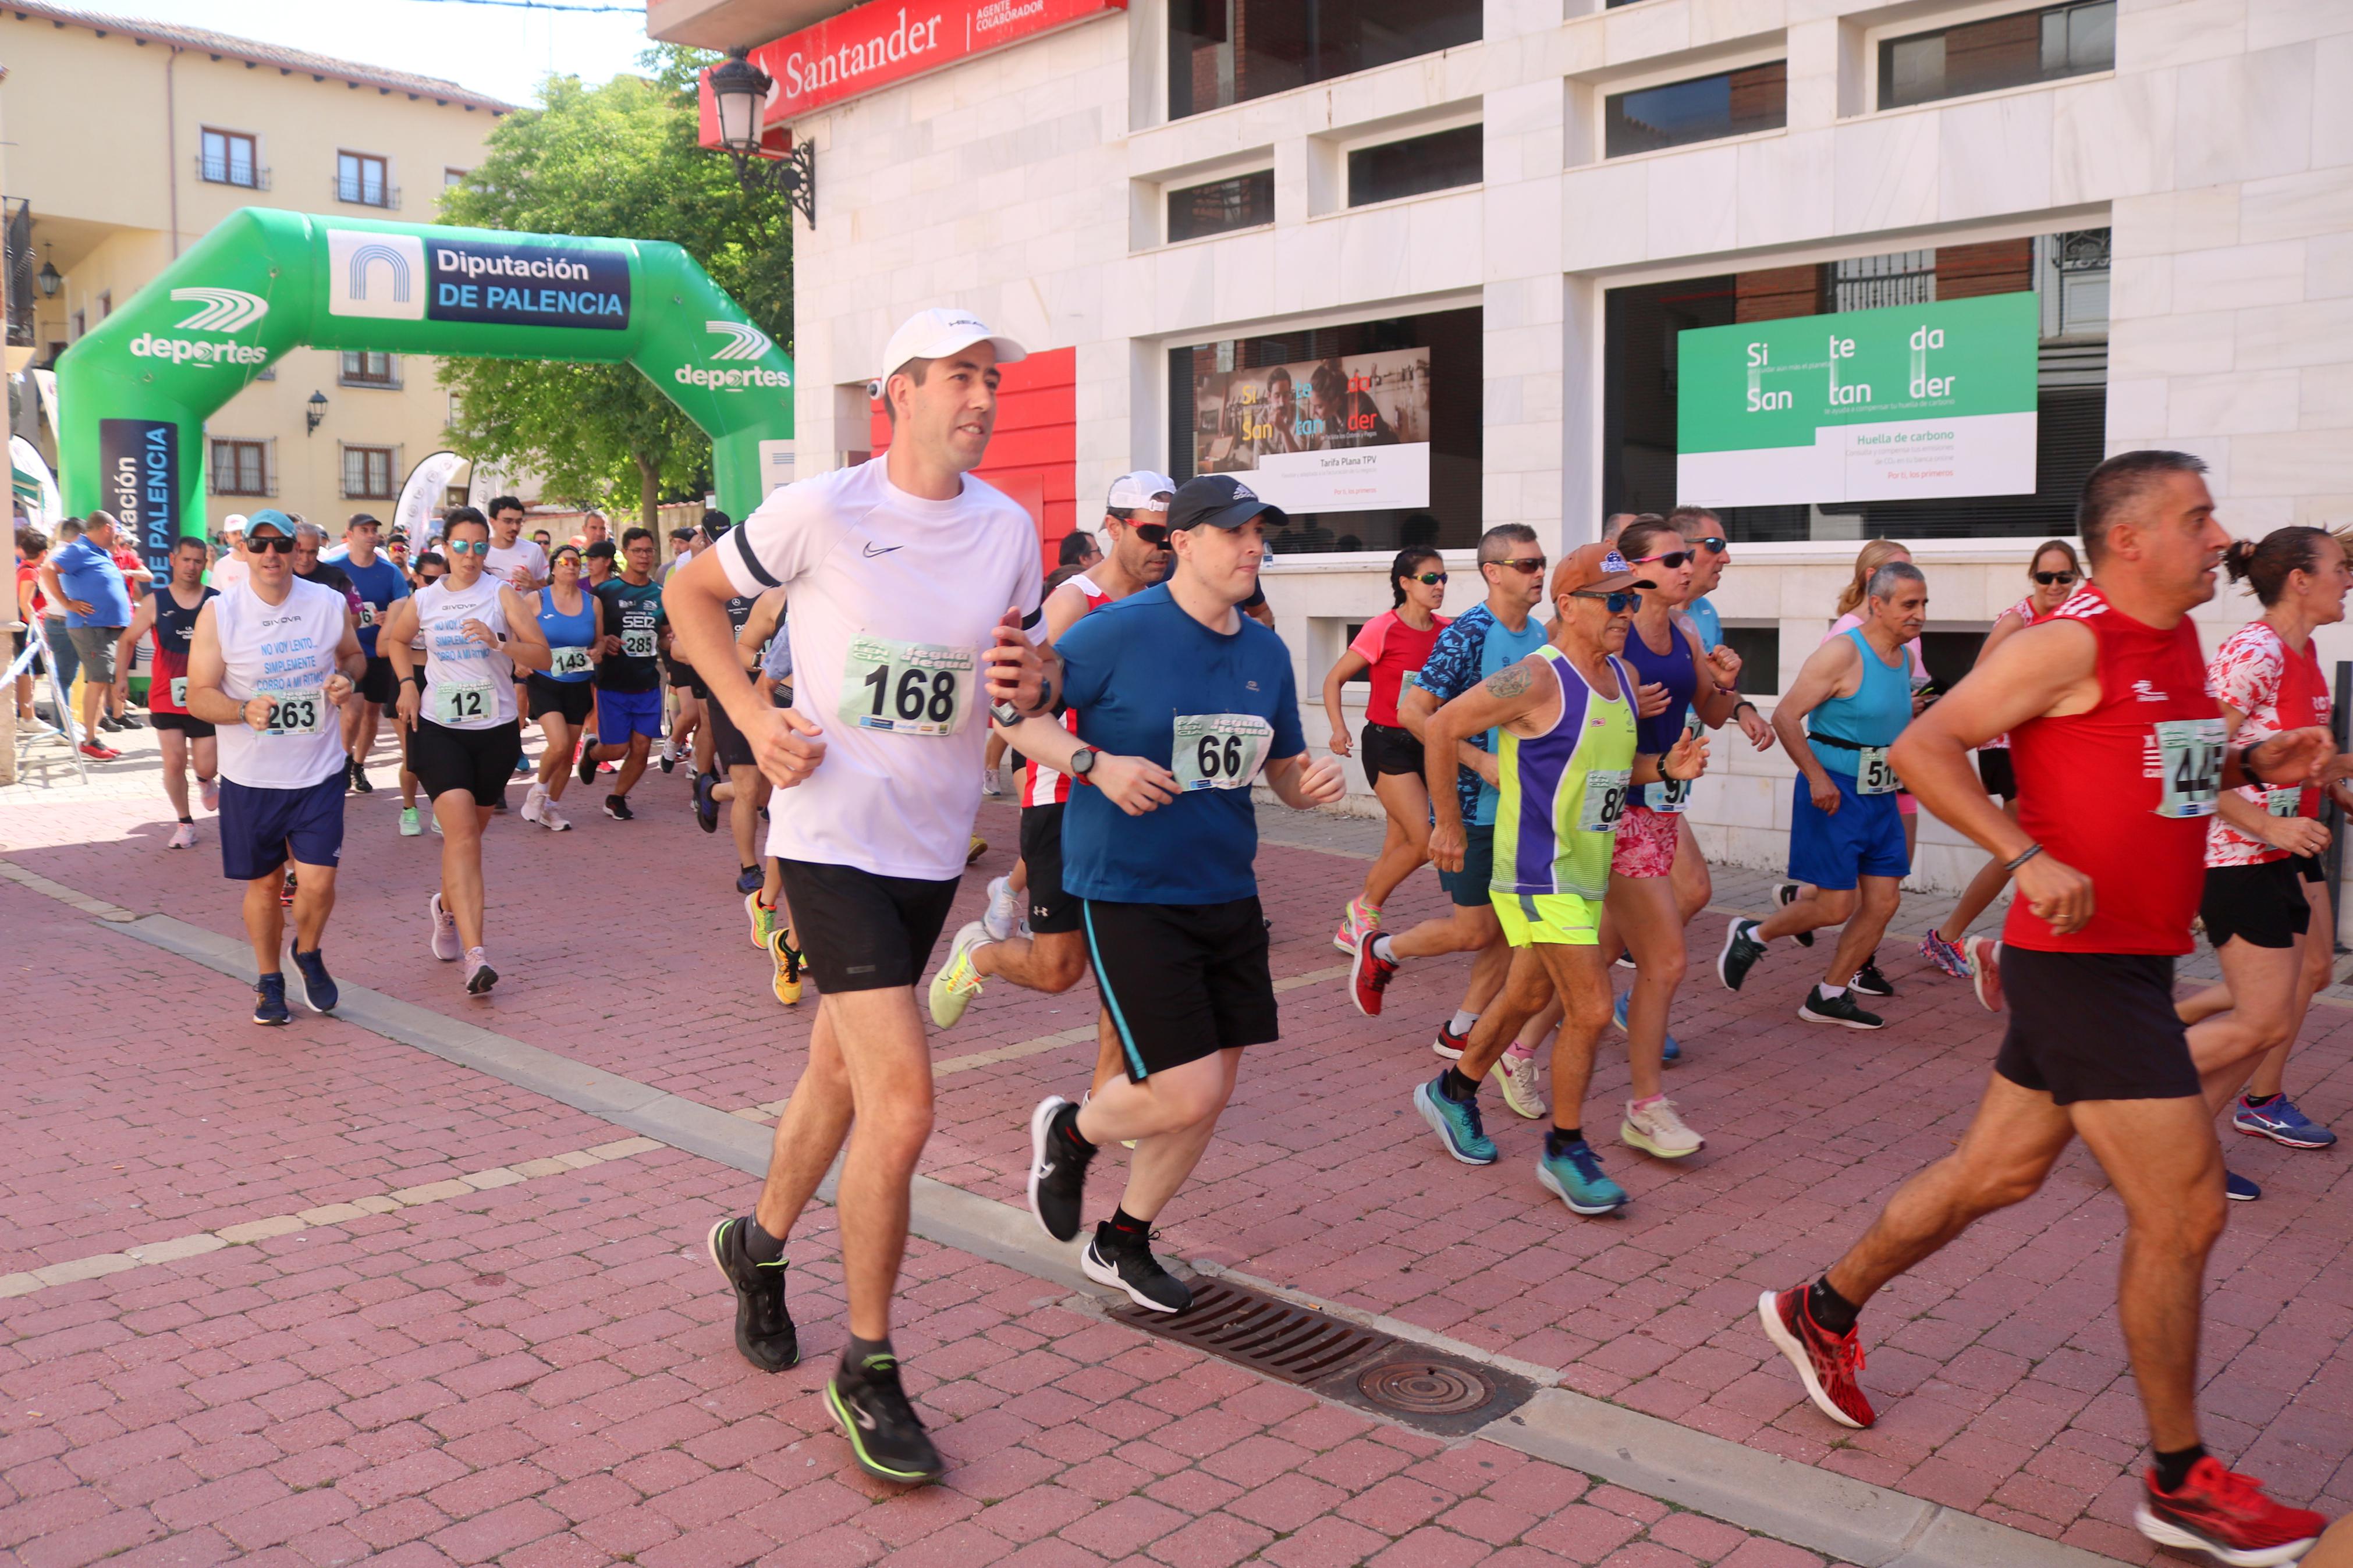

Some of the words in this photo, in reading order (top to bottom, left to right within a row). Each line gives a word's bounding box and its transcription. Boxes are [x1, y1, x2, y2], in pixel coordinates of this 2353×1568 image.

[976, 0, 1011, 20] AGENTE
[976, 1, 1044, 32] COLABORADOR
[786, 8, 942, 99] Santander
[436, 248, 590, 281] Diputación
[439, 283, 479, 308] DE
[487, 286, 624, 316] PALENCIA
[130, 332, 268, 365] deportes
[1747, 342, 1768, 367] Si
[1829, 334, 1855, 359] te
[1910, 325, 1944, 351] da
[675, 363, 791, 391] deportes
[1242, 385, 1257, 405] Si
[1296, 380, 1312, 400] te
[1347, 372, 1371, 393] da
[1747, 387, 1793, 413] San
[1829, 382, 1872, 406] tan
[1910, 372, 1955, 399] der
[1929, 399, 1955, 407] carbono
[1242, 422, 1273, 441] San
[1296, 418, 1323, 436] tan
[1347, 409, 1378, 431] der
[1858, 433, 1891, 445] Huella
[1894, 432, 1908, 443] de
[1911, 430, 1954, 442] carbono
[1321, 459, 1339, 467] Tarifa
[1341, 457, 1361, 466] Plana
[1363, 456, 1376, 464] TPV
[1888, 471, 1900, 479] Por
[1921, 469, 1954, 479] primeros
[146, 427, 170, 549] PALENCIA
[150, 556, 171, 589] DE
[446, 620, 457, 630] VOY
[261, 643, 273, 656] NO
[274, 641, 288, 653] VOY
[457, 651, 463, 660] A
[627, 638, 652, 652] 285
[853, 652, 890, 663] CIA
[854, 646, 889, 656] LEN
[264, 656, 316, 674] SIMPLEMENTE
[556, 653, 586, 671] 143
[256, 678, 285, 691] CORRO
[286, 678, 292, 689] A
[293, 676, 302, 688] MI
[303, 670, 324, 686] RITMO
[865, 664, 955, 722] 168
[268, 701, 315, 729] 263
[451, 692, 482, 716] 12
[1198, 735, 1242, 778] 66
